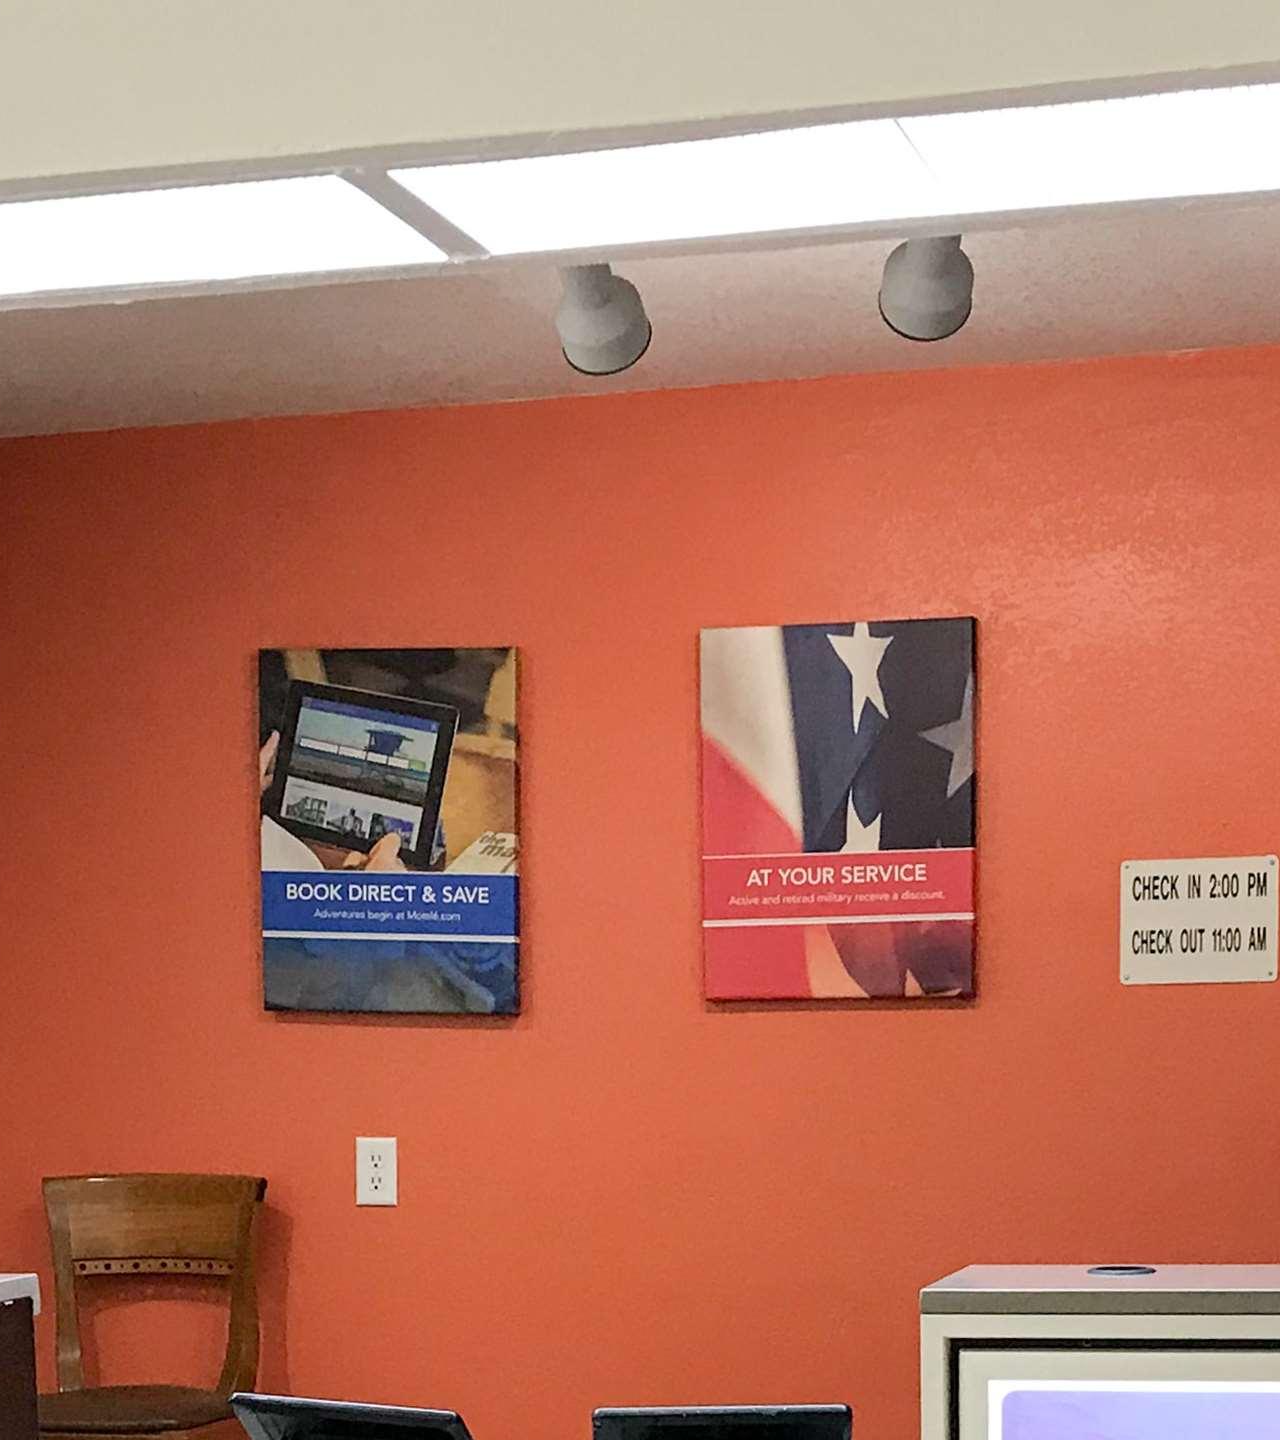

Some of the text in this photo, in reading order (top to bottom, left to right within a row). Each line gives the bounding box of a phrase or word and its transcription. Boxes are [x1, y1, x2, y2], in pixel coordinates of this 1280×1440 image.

[746, 864, 928, 887] AT YOUR SERVICE
[286, 883, 490, 903] BOOK DIRECT & SAVE
[1132, 872, 1268, 901] CHECK IN 2:00 PM
[728, 896, 760, 906] Active
[761, 895, 781, 905] and
[782, 894, 815, 904] retired
[816, 893, 852, 905] military
[854, 892, 890, 902] receive
[313, 908, 365, 919] Adventures
[367, 910, 393, 922] begin
[395, 912, 405, 921] at
[1132, 926, 1267, 954] CHECK OUT 11:00 AM
